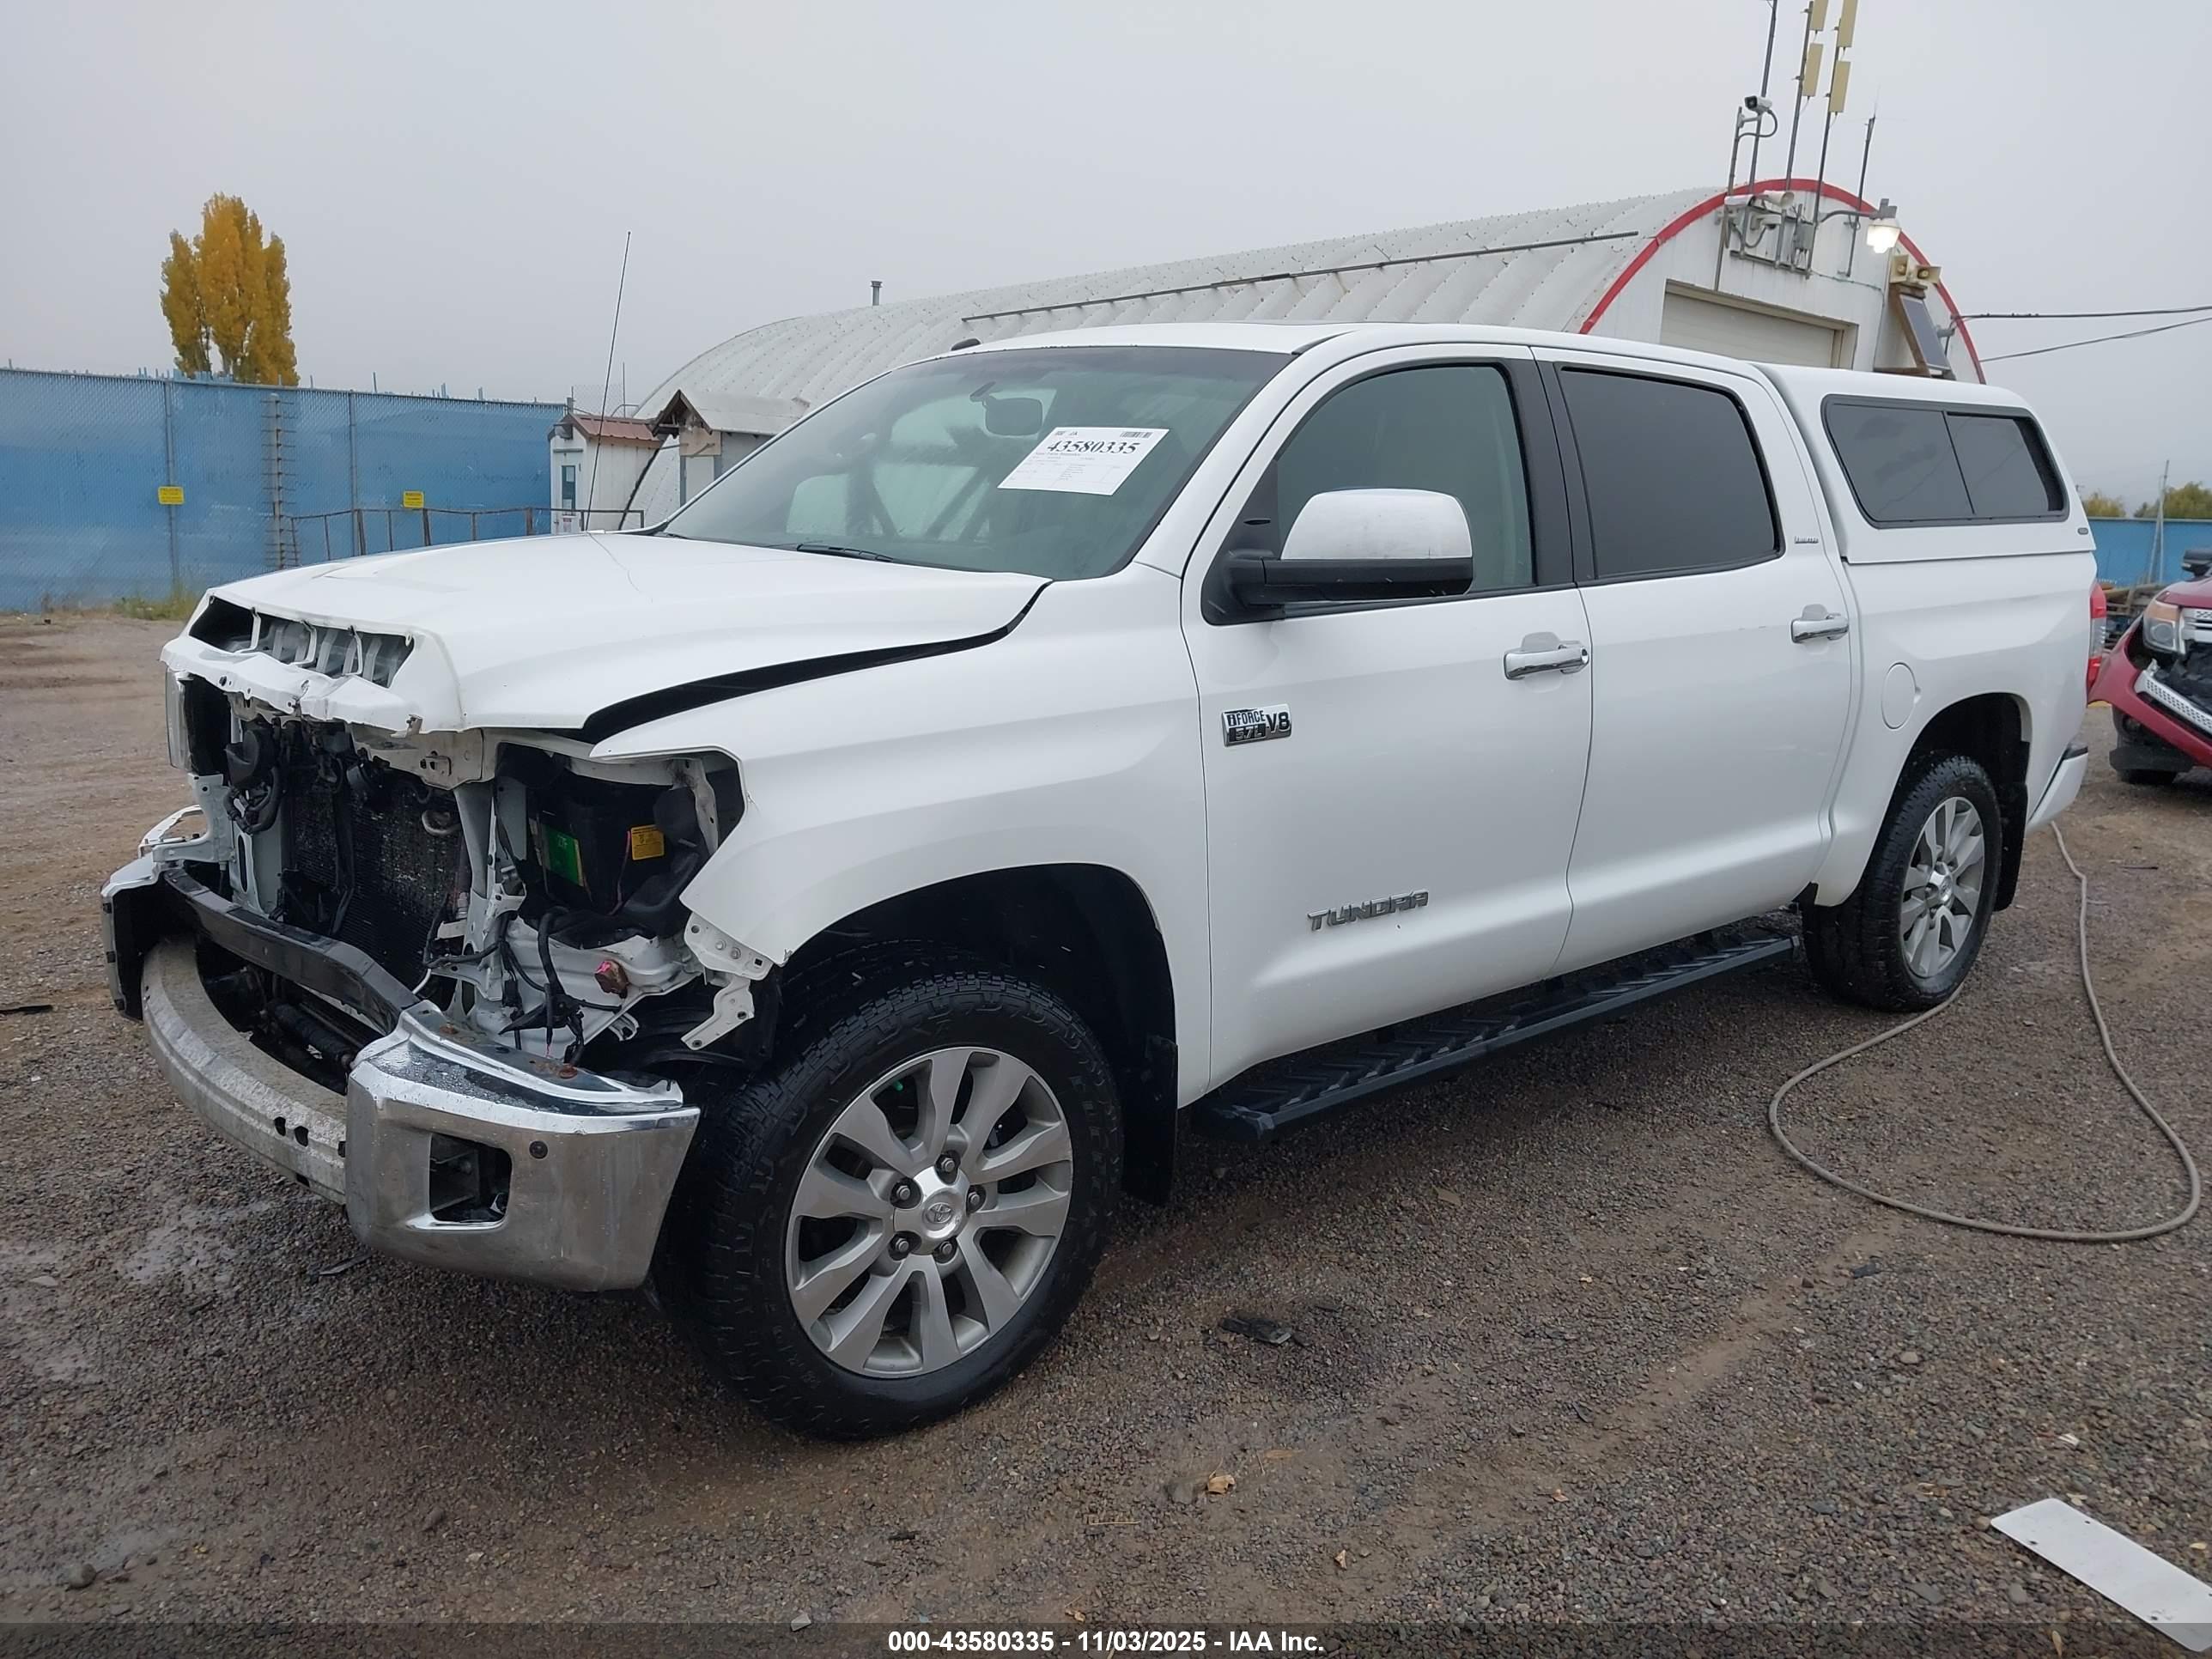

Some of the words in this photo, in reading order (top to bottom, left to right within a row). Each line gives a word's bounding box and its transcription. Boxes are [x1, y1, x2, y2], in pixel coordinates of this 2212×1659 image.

[1047, 440, 1140, 453] 43580335
[1266, 711, 1291, 733] V8
[1307, 890, 1429, 931] TUNDRA
